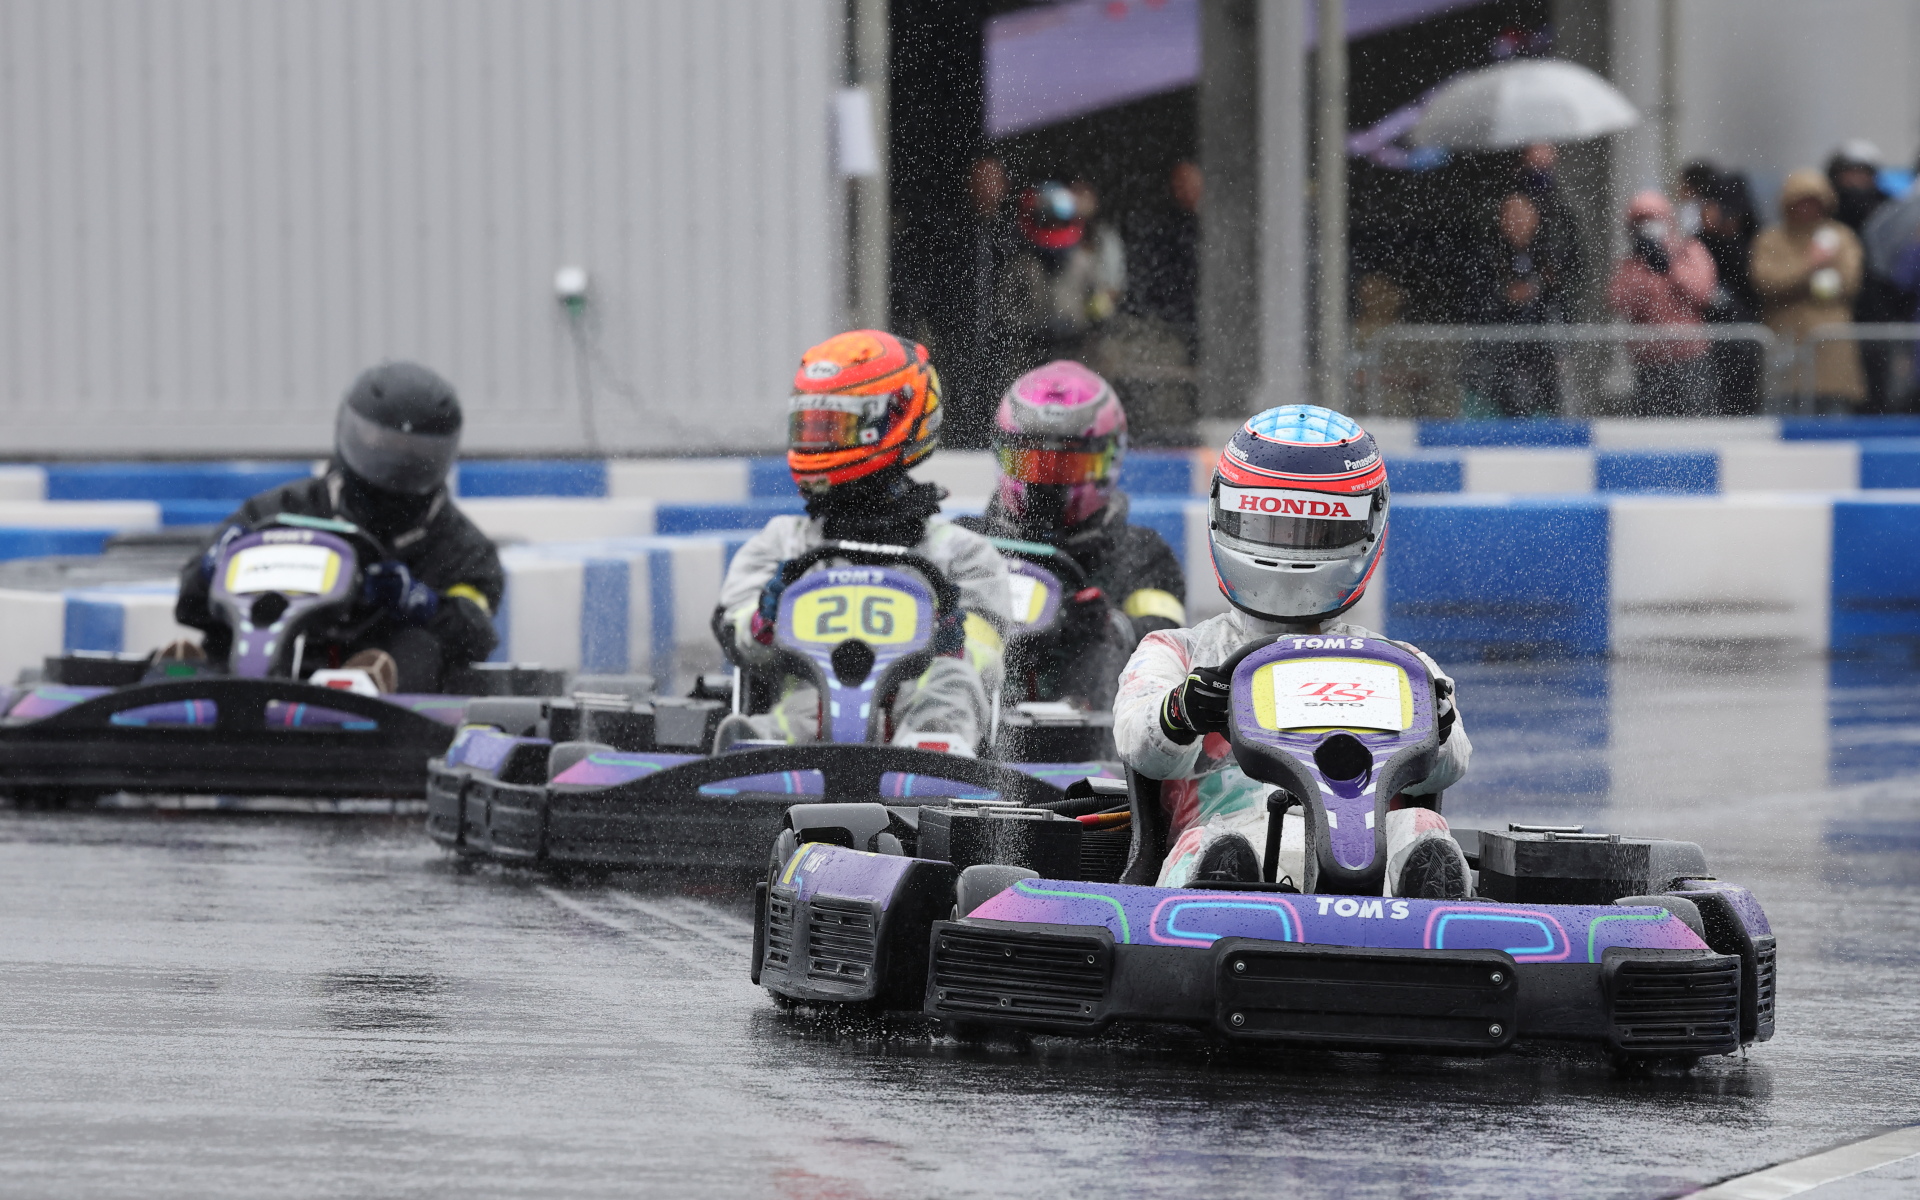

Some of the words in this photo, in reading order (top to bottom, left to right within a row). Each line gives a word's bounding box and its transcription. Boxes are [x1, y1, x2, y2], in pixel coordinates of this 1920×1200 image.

[1238, 494, 1352, 518] HONDA
[816, 595, 895, 636] 26
[1292, 637, 1365, 650] TOM'S
[1315, 896, 1410, 920] TOM'S
